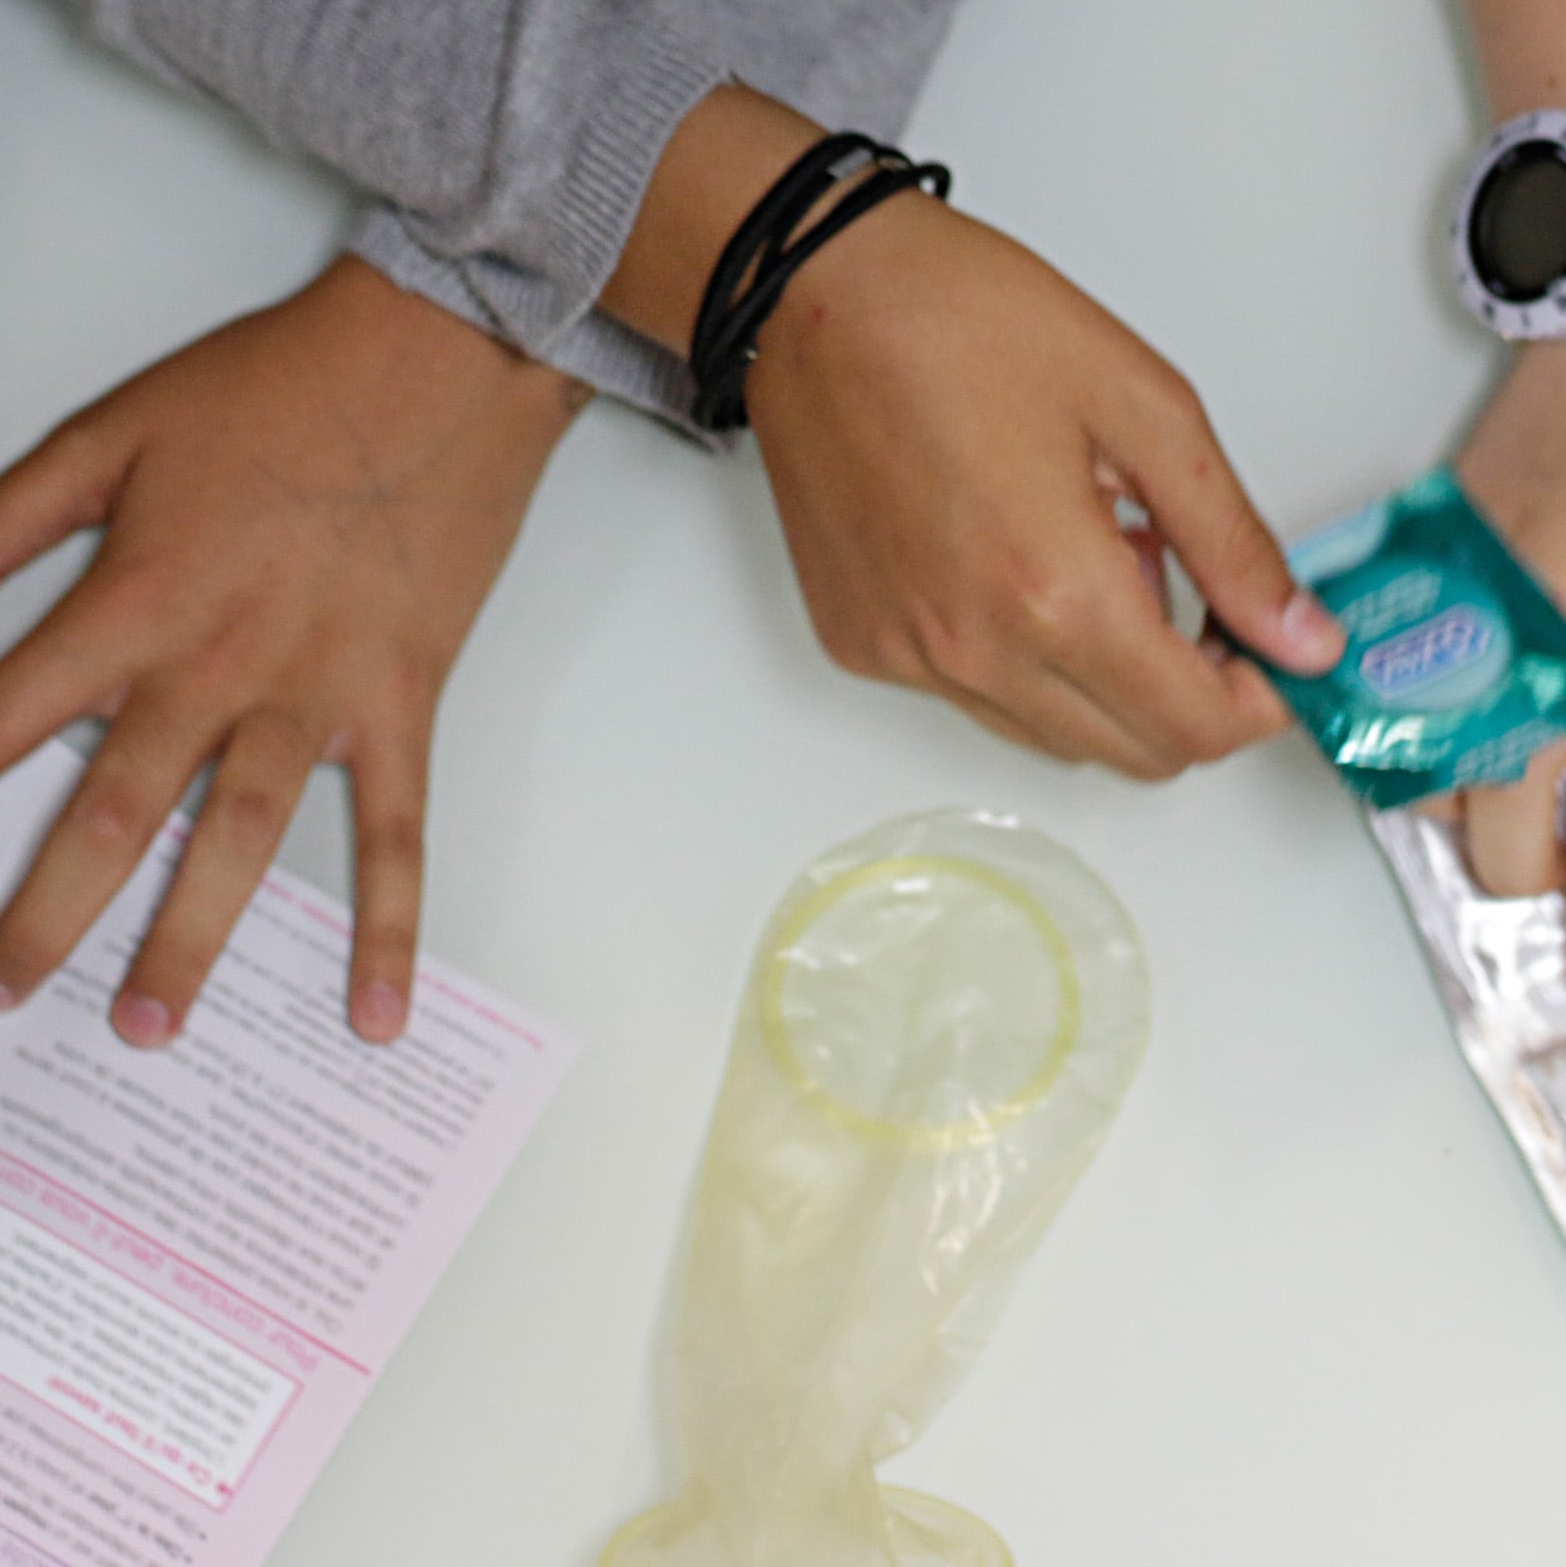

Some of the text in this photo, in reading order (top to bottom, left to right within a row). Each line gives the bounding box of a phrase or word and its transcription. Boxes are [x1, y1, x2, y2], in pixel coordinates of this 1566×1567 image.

[36, 1187, 92, 1231] vous
[166, 1264, 268, 1337] conclure,
[262, 1326, 322, 1374] Pour
[42, 1372, 104, 1419] savoir
[181, 1458, 214, 1487] Ce
